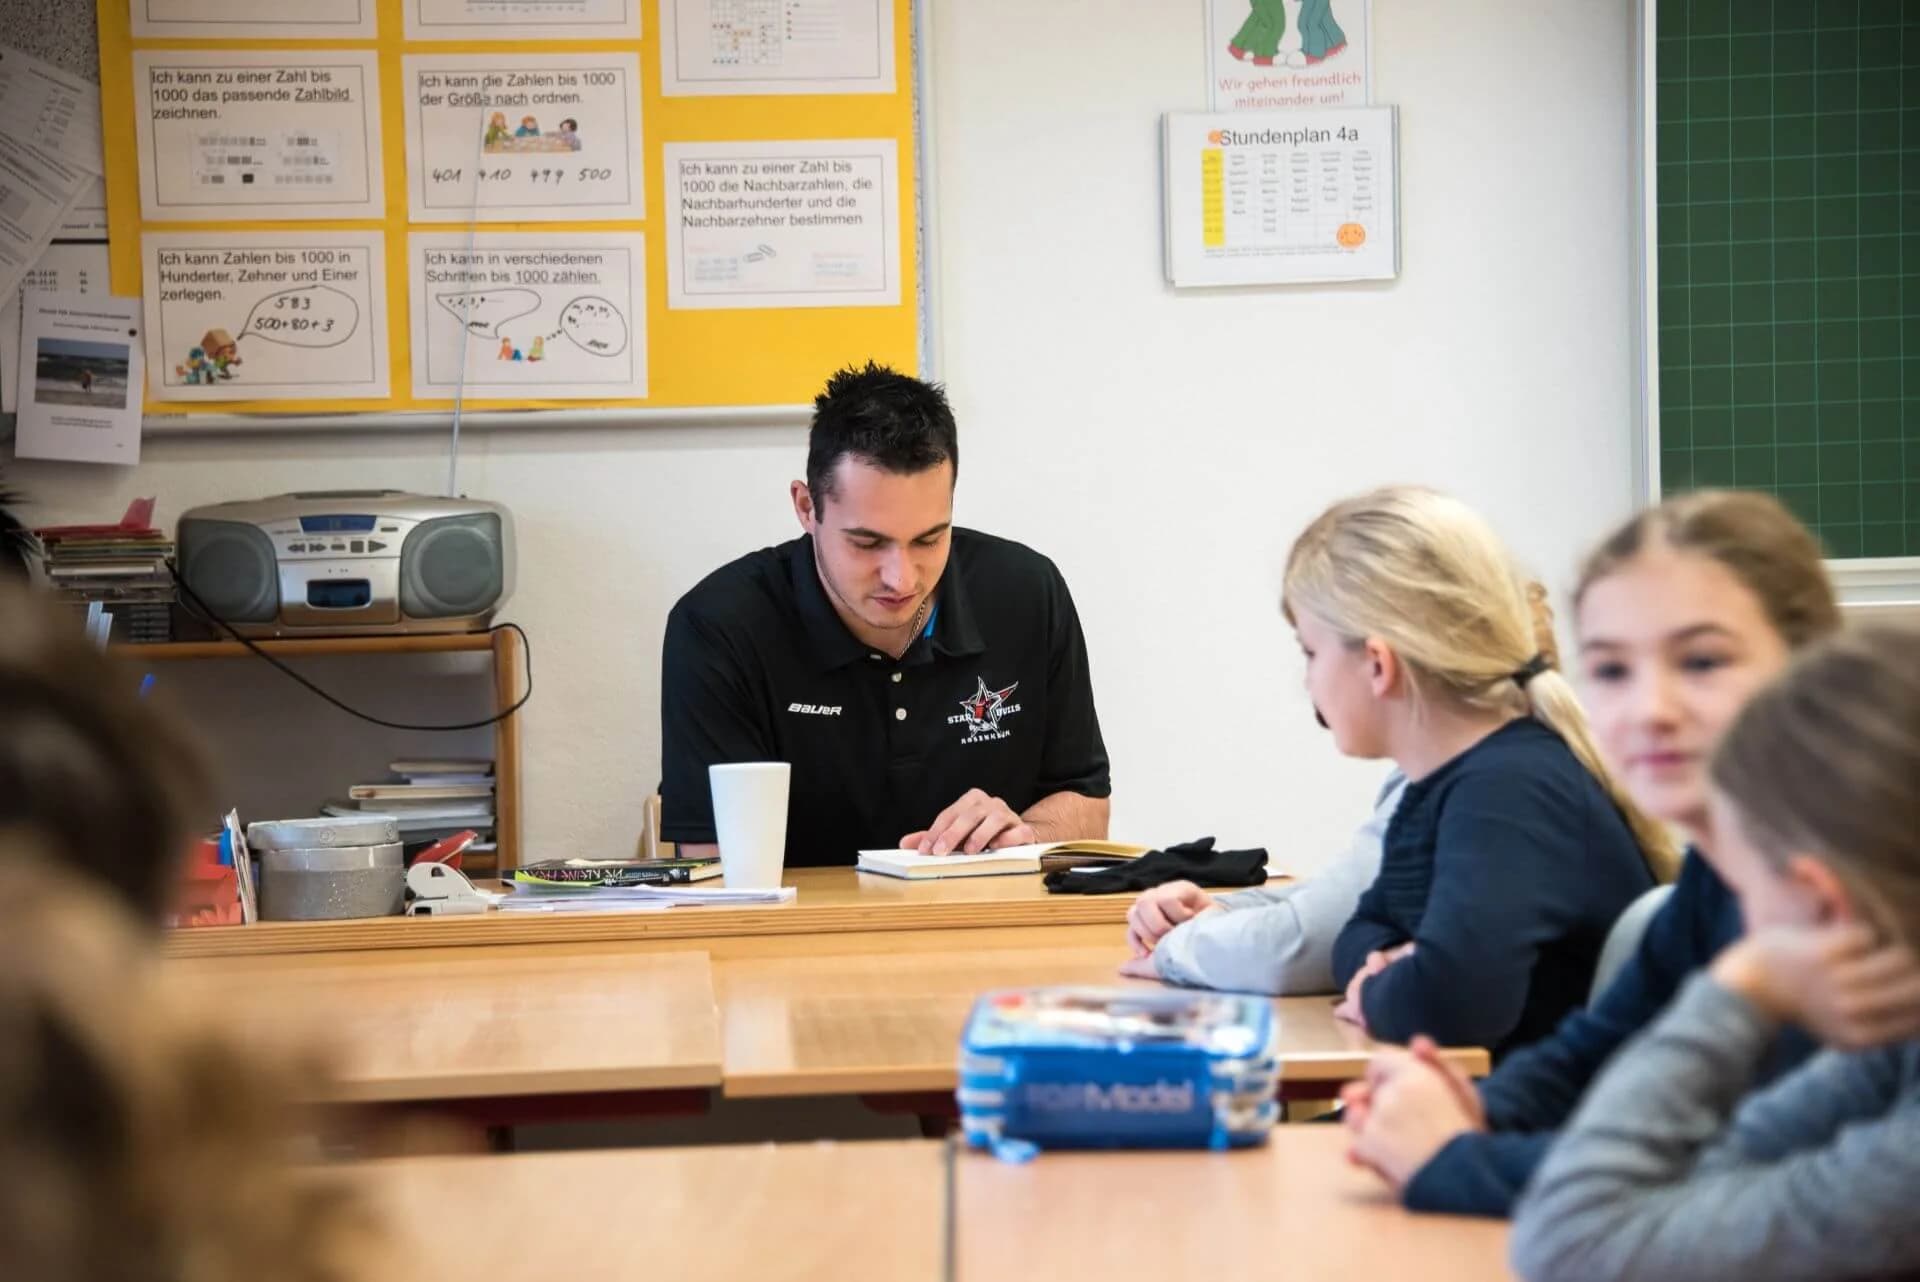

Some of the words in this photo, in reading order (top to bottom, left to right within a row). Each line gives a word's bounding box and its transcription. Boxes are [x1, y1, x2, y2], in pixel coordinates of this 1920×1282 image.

[152, 71, 173, 84] Ich
[177, 70, 212, 84] kann
[216, 73, 233, 84] zu
[237, 70, 271, 84] einer
[276, 70, 307, 83] Zahl
[311, 70, 331, 83] bis
[420, 75, 441, 88] Ich
[445, 74, 478, 88] kann
[483, 73, 503, 87] die
[507, 73, 554, 87] Zahlen
[558, 73, 578, 86] bis
[583, 72, 615, 86] 1000
[1219, 77, 1242, 92] Wir
[1247, 75, 1288, 93] gehen
[1291, 72, 1361, 89] freundlich
[153, 89, 188, 102] 1000
[192, 88, 218, 102] das
[222, 88, 290, 104] passende
[295, 87, 350, 102] Zahlbild
[421, 93, 443, 106] der
[494, 92, 528, 106] nach
[532, 92, 583, 105] ordnen.
[1234, 92, 1315, 109] miteinander
[1319, 90, 1345, 106] um!
[153, 105, 221, 120] zeichnen.
[1219, 127, 1331, 147] Stundenplan
[1335, 126, 1359, 142] 4a
[432, 168, 463, 183] 401
[579, 168, 611, 182] 500
[681, 163, 701, 176] Ich
[705, 162, 738, 175] kann
[742, 164, 758, 175] zu
[762, 161, 795, 175] einer
[800, 160, 829, 174] Zahl
[833, 160, 852, 173] bis
[683, 180, 715, 193] 1000
[719, 179, 739, 192] die
[743, 178, 848, 193] Nachbarzahlen,
[852, 177, 873, 190] die
[682, 196, 802, 210] Nachbarhunderter
[807, 195, 832, 208] und
[836, 195, 857, 208] die
[683, 213, 785, 228] Nachbarzehner
[789, 212, 863, 226] bestimmen
[160, 253, 181, 266] Ich
[185, 252, 219, 266] kann
[223, 252, 271, 266] Zahlen
[275, 251, 296, 265] bis
[302, 251, 334, 264] 1000
[338, 250, 350, 263] in
[426, 253, 447, 266] Ich
[451, 252, 483, 266] kann
[488, 252, 500, 265] in
[504, 252, 603, 266] verschiedenen
[161, 269, 234, 284] Hunderter,
[238, 269, 288, 282] Zehner
[292, 268, 318, 281] und
[322, 268, 358, 281] Einer
[427, 269, 487, 283] Schritten
[491, 269, 510, 282] bis
[516, 270, 549, 282] 1000
[161, 287, 225, 304] zerlegen.
[274, 296, 311, 310] 583
[947, 713, 973, 725] STAR
